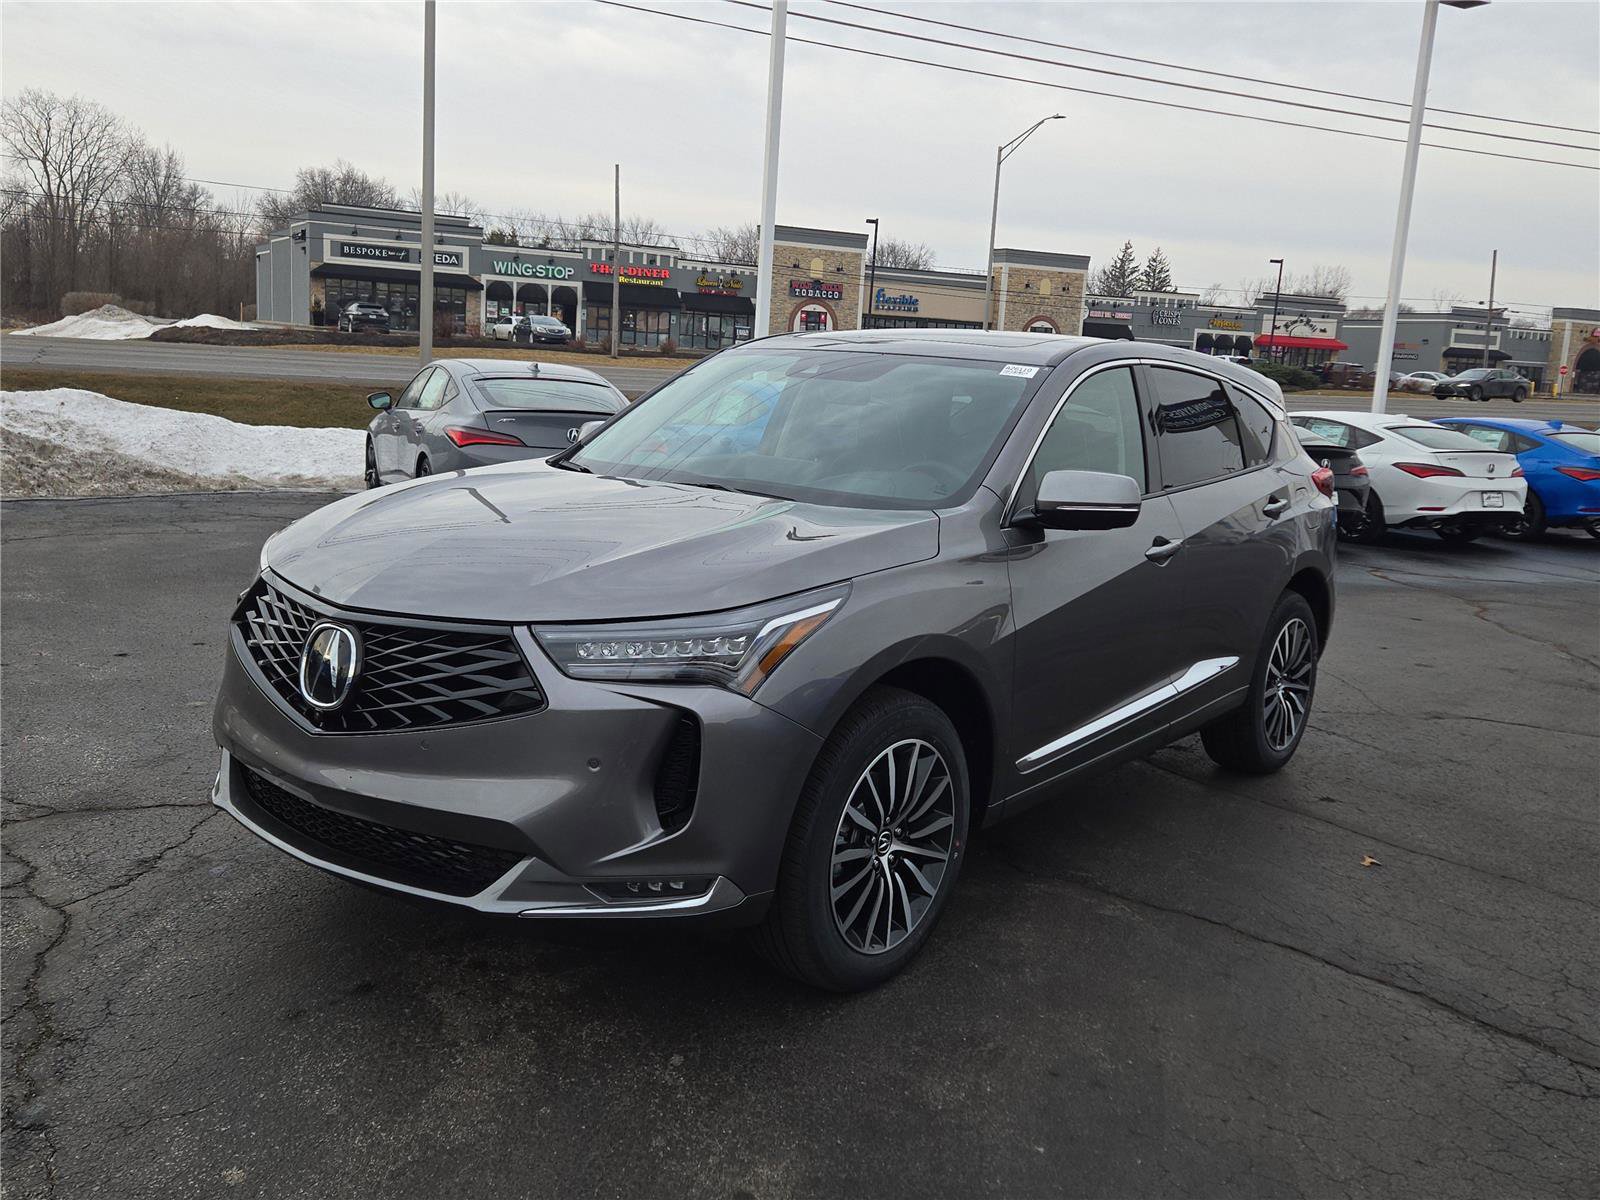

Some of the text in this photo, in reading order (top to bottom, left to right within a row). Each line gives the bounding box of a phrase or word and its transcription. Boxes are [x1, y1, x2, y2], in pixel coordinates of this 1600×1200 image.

[343, 246, 389, 257] BESPOKE
[618, 276, 664, 286] Restaurant
[794, 289, 840, 299] TOBACCO
[876, 287, 920, 306] flexible
[1158, 317, 1181, 325] CONES
